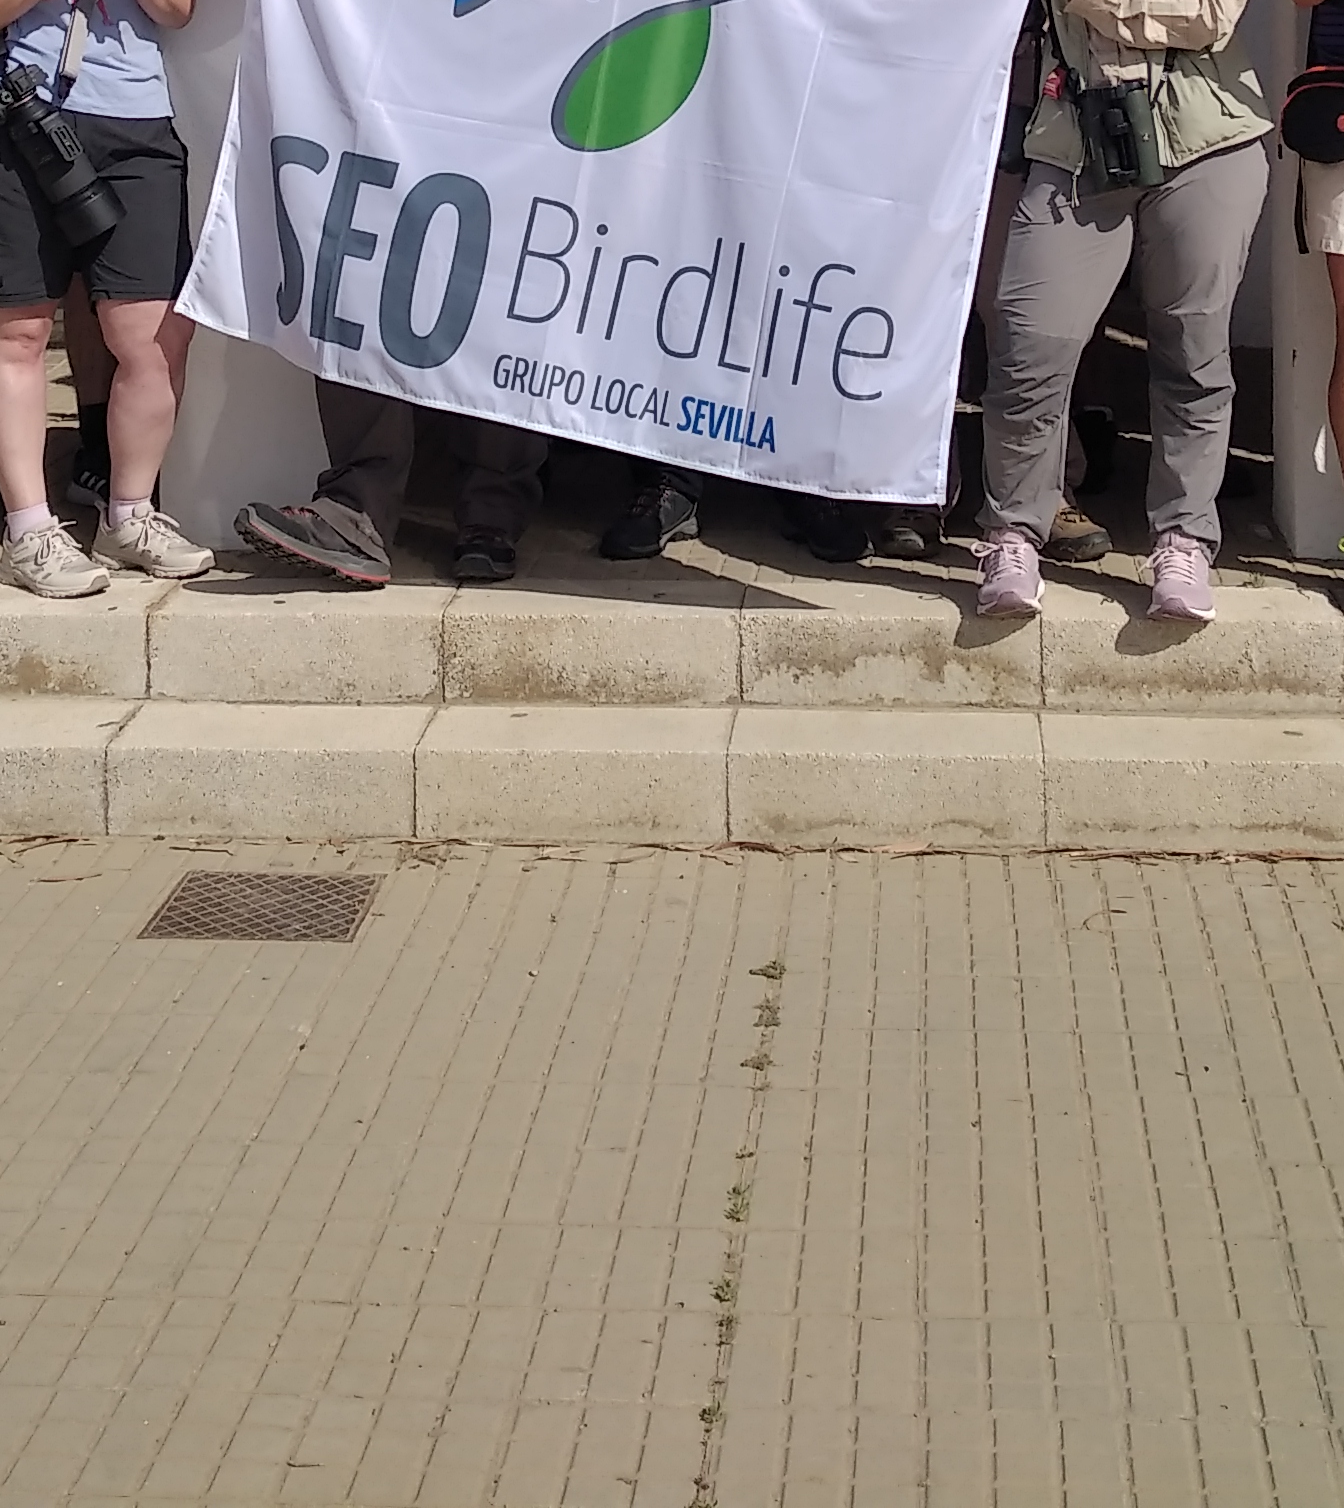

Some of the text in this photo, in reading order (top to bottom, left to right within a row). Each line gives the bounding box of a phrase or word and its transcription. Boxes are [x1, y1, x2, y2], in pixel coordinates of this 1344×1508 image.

[271, 135, 896, 401] SEO BirdLife
[493, 354, 776, 454] GRUPO LOCAL SEVILLA
